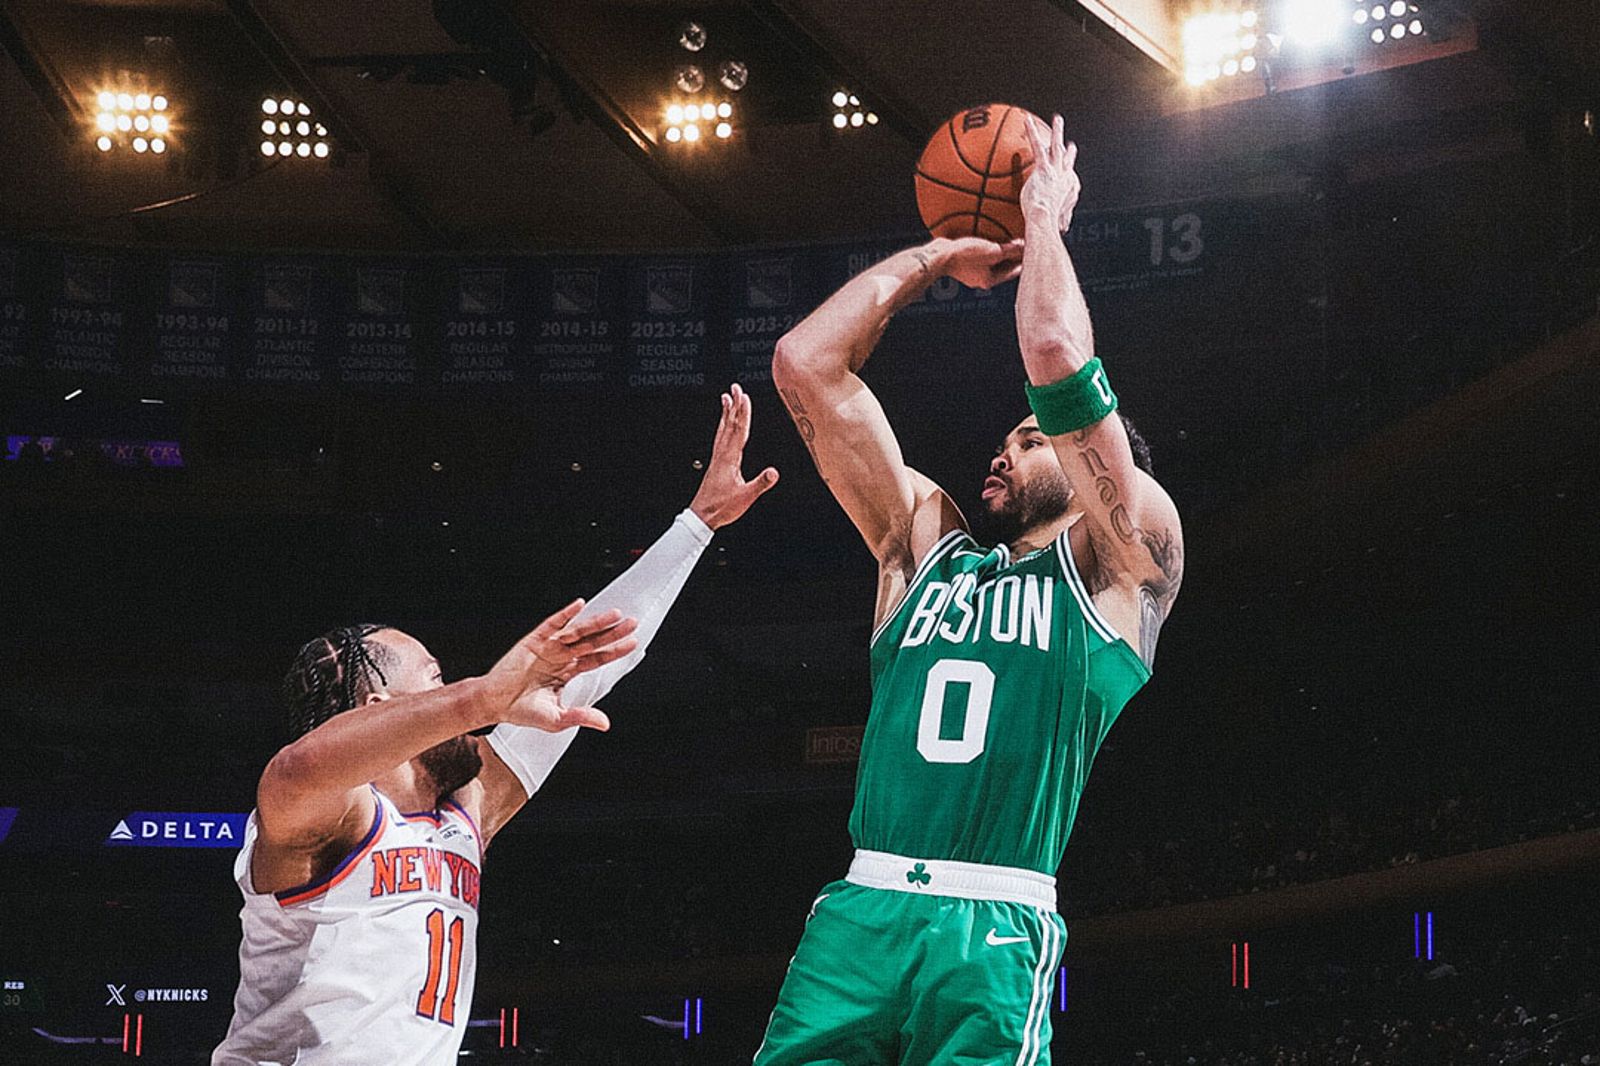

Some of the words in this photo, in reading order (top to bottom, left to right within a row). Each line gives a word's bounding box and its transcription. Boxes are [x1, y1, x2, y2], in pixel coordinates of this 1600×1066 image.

[1069, 223, 1119, 245] ISH
[1144, 213, 1203, 265] 13
[157, 315, 228, 331] 1993-94
[254, 318, 318, 335] 2011-12
[346, 323, 412, 338] 2013-14
[447, 321, 515, 337] 2014-15
[540, 321, 608, 337] 2014-15
[631, 321, 705, 338] 2023-24
[636, 344, 698, 356] REGULAR
[640, 359, 693, 371] SEASON
[629, 373, 704, 387] CHAMPIONS
[917, 658, 996, 763] 0
[812, 732, 859, 755] Infos
[141, 821, 233, 839] DELTA
[370, 847, 443, 898] NEW
[444, 850, 480, 911] YOR
[416, 908, 464, 1027] 11
[4, 981, 25, 990] REB
[3, 994, 21, 1006] 30
[134, 988, 208, 1002] @NYKNICKS
